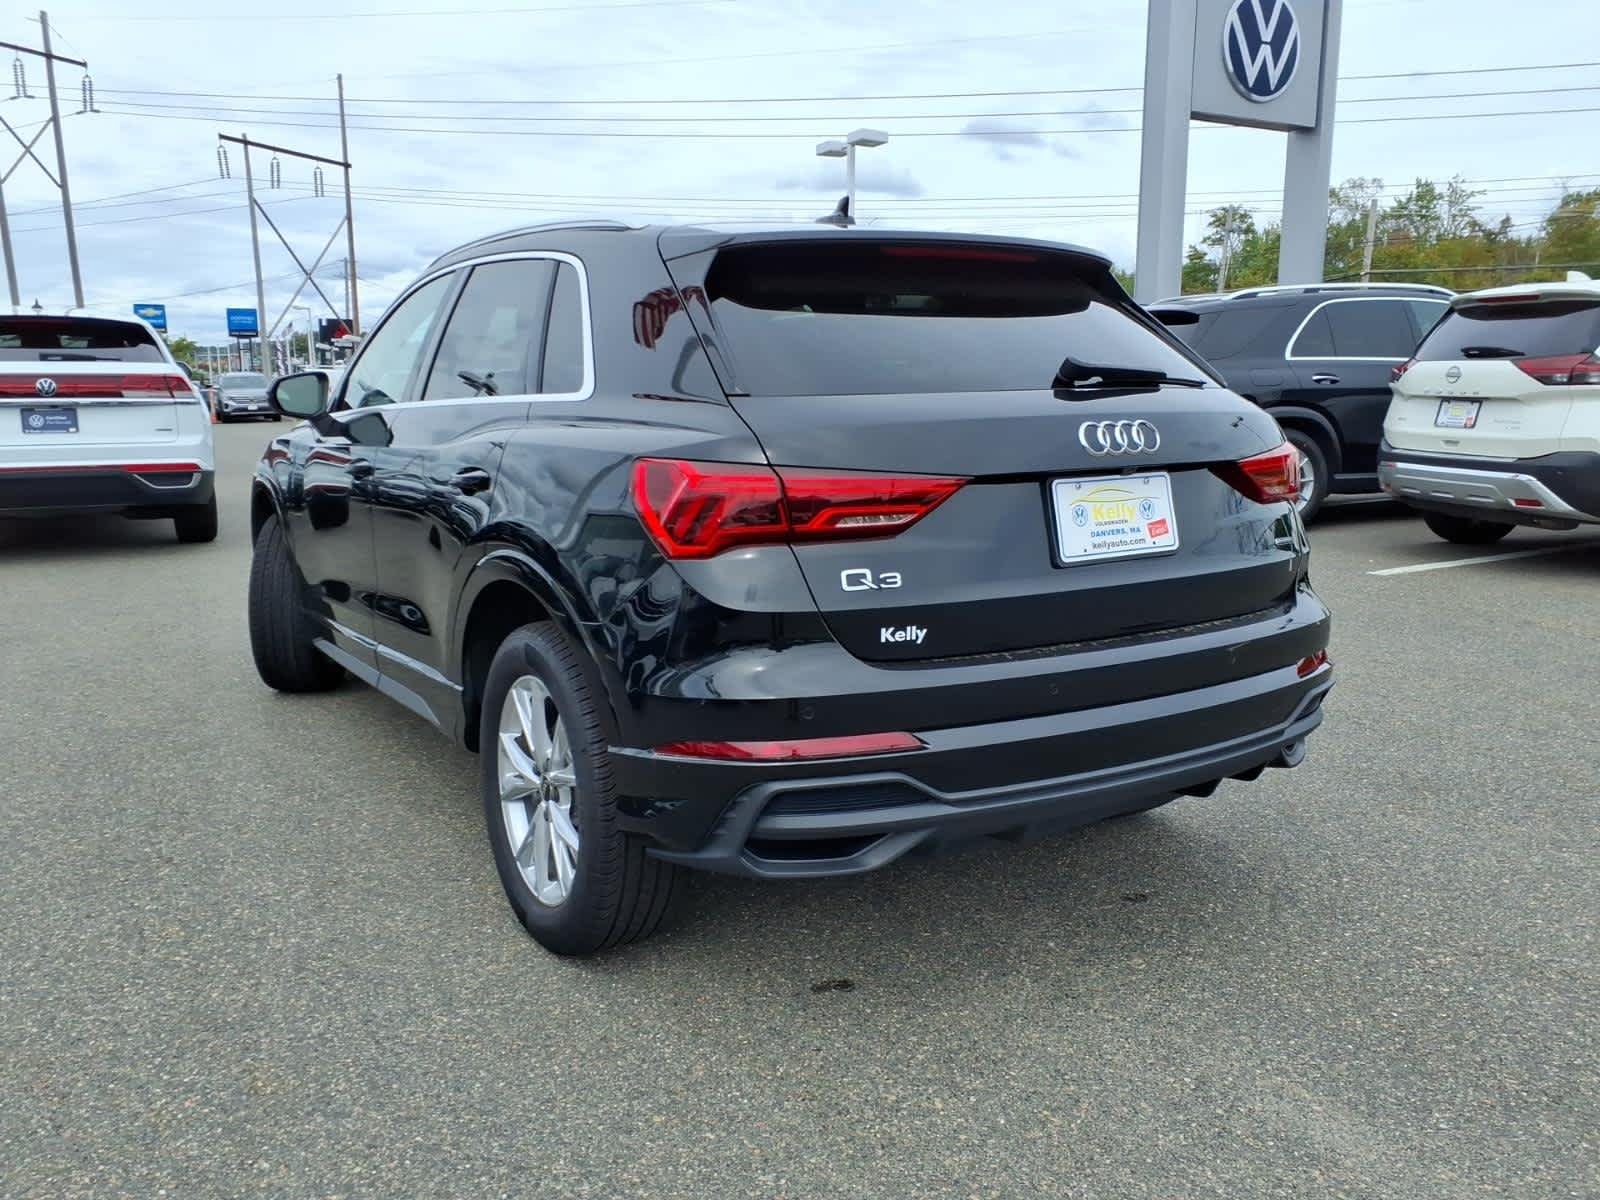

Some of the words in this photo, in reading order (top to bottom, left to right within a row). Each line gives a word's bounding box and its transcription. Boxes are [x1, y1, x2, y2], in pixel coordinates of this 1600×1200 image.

[1226, 0, 1299, 97] VW
[1092, 503, 1137, 522] Kelly
[1091, 537, 1146, 550] kellyauto.com
[841, 568, 902, 592] Q3
[880, 625, 928, 644] Kelly
